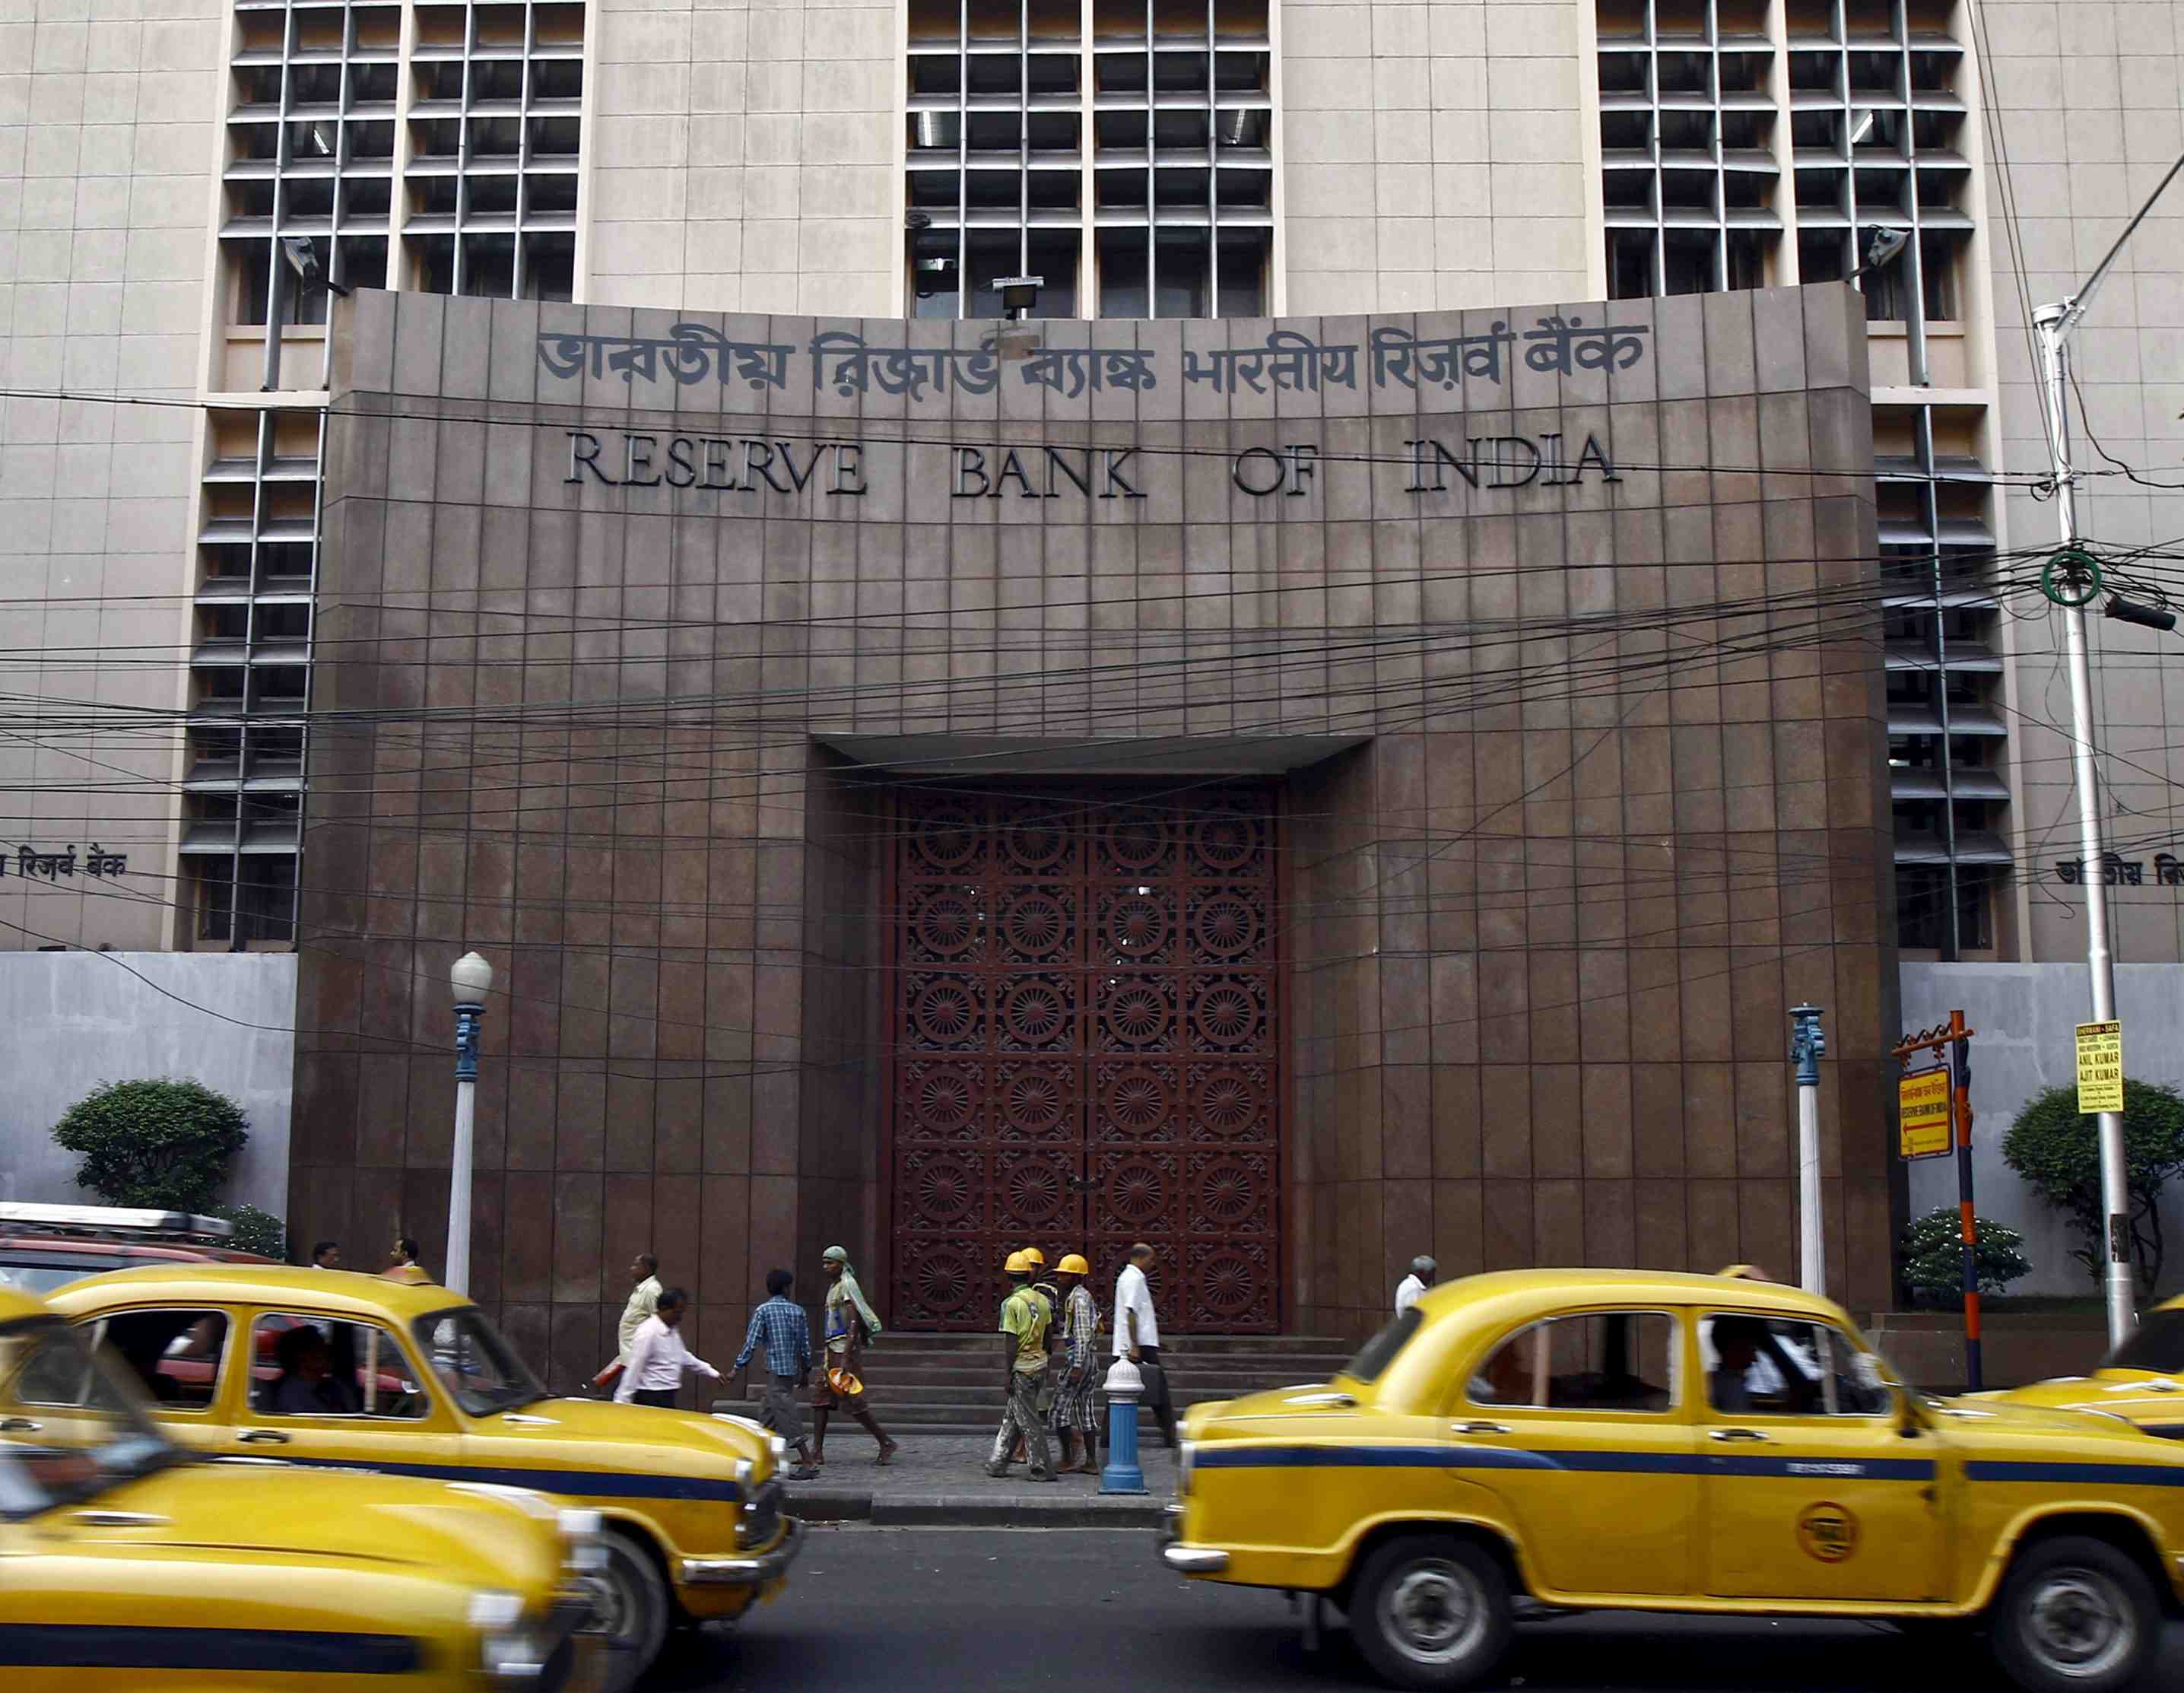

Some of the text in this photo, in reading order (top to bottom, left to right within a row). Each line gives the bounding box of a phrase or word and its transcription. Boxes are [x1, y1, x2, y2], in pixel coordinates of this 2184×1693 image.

[537, 322, 796, 391] ভারতীয়
[1184, 330, 1359, 394] भारतीय
[1524, 316, 1649, 376] बैंक
[563, 431, 1623, 498] RESERVE BANK OF INDIA
[2095, 1052, 2119, 1064] KUMAR
[2095, 1068, 2119, 1081] KUMAR
